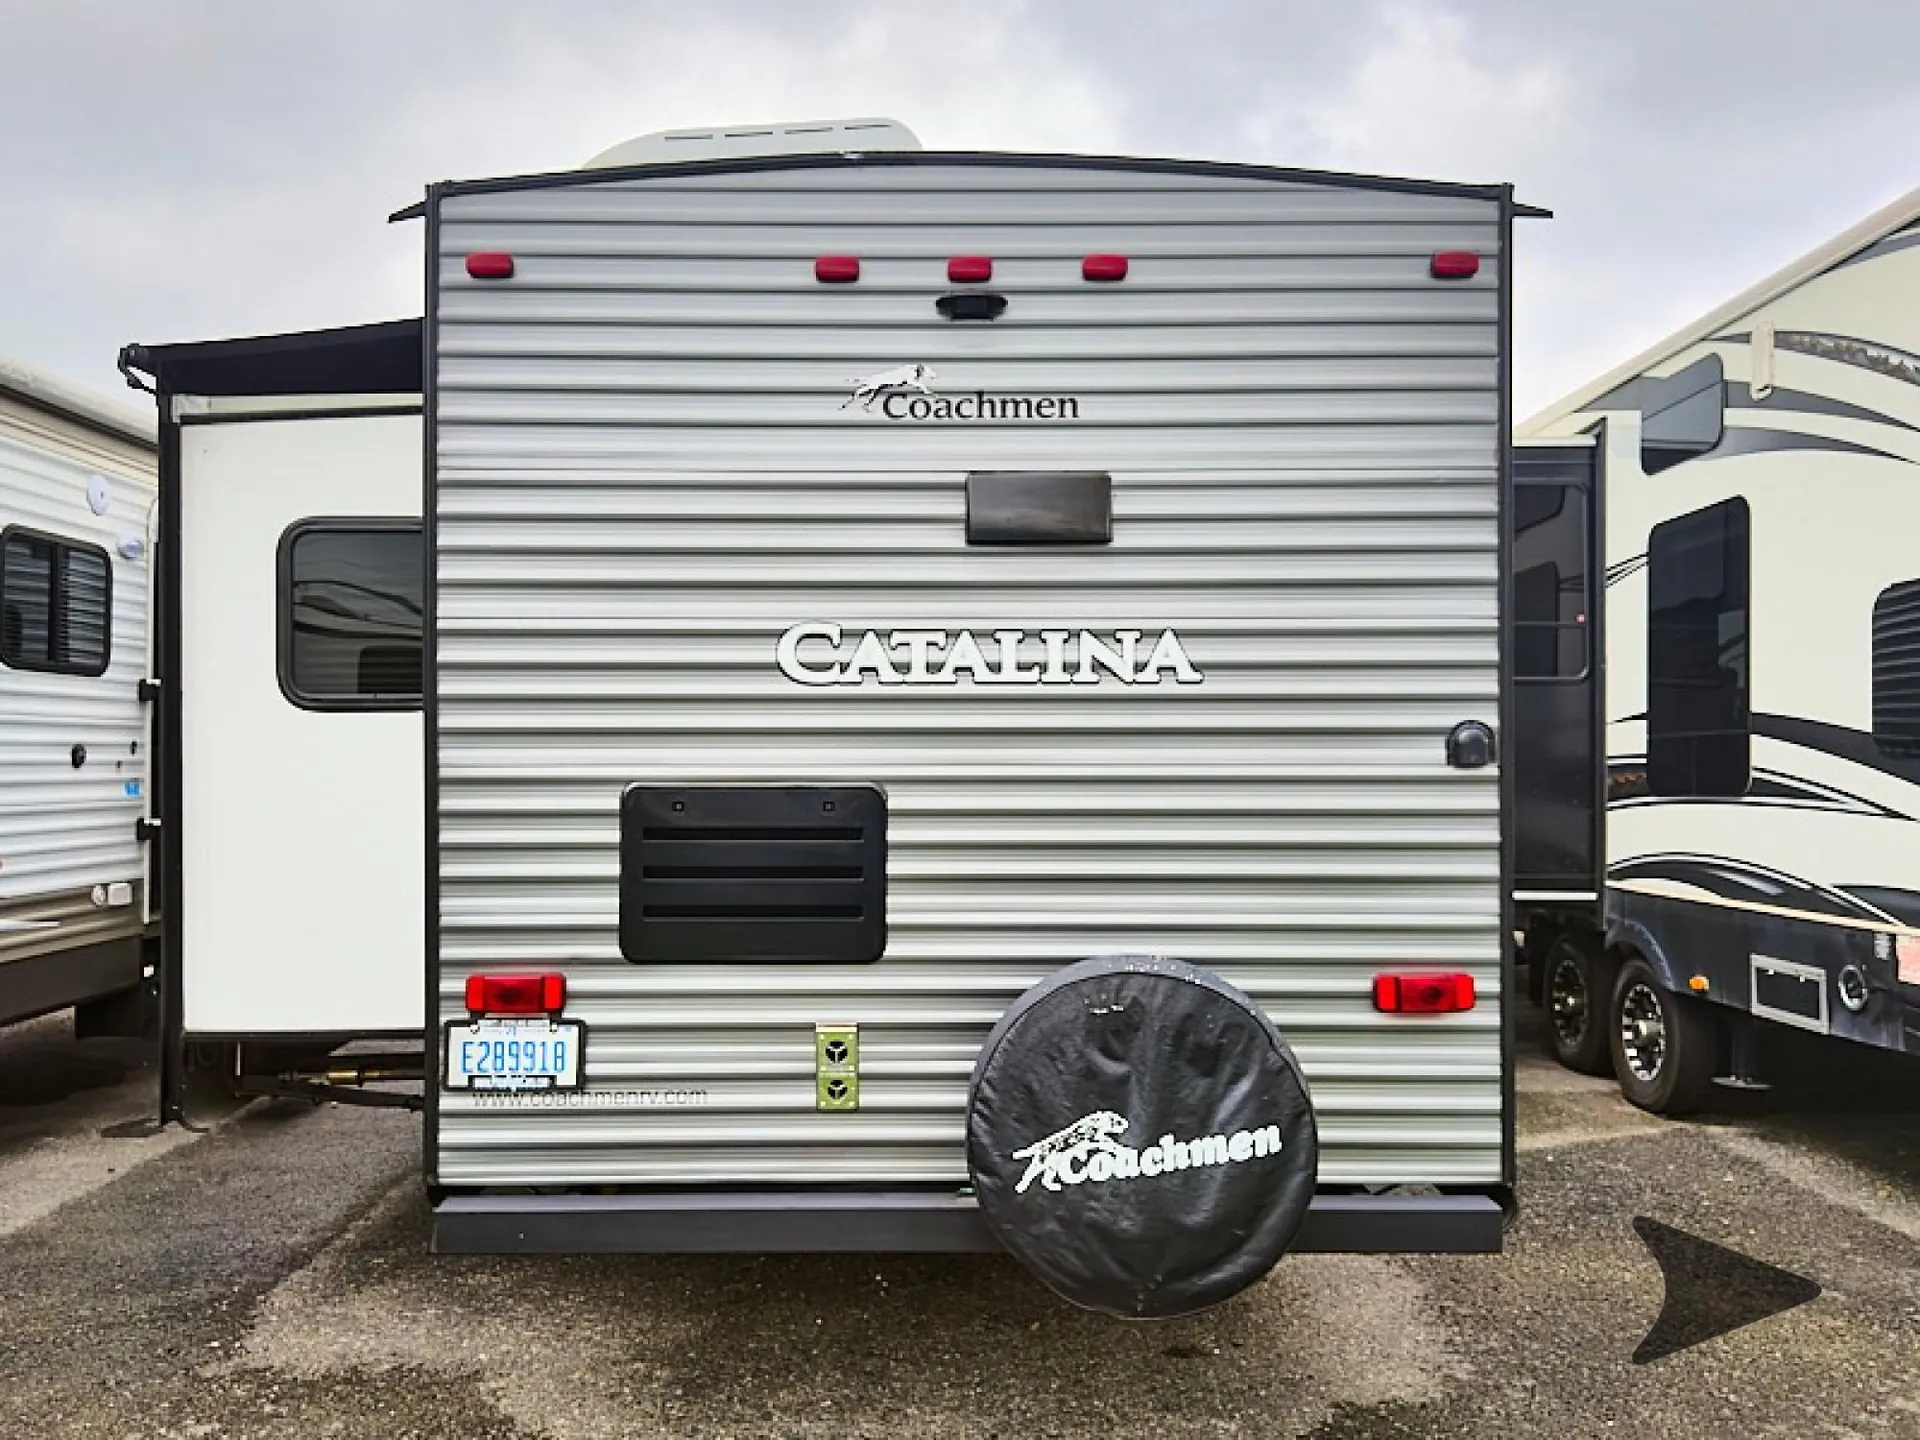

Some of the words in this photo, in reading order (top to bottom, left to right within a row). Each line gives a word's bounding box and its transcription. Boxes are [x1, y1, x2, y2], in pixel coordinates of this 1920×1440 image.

[882, 390, 1080, 420] Coachmen
[472, 1088, 708, 1107] www.coachmenrv.com
[1056, 1123, 1283, 1185] Coachmen
